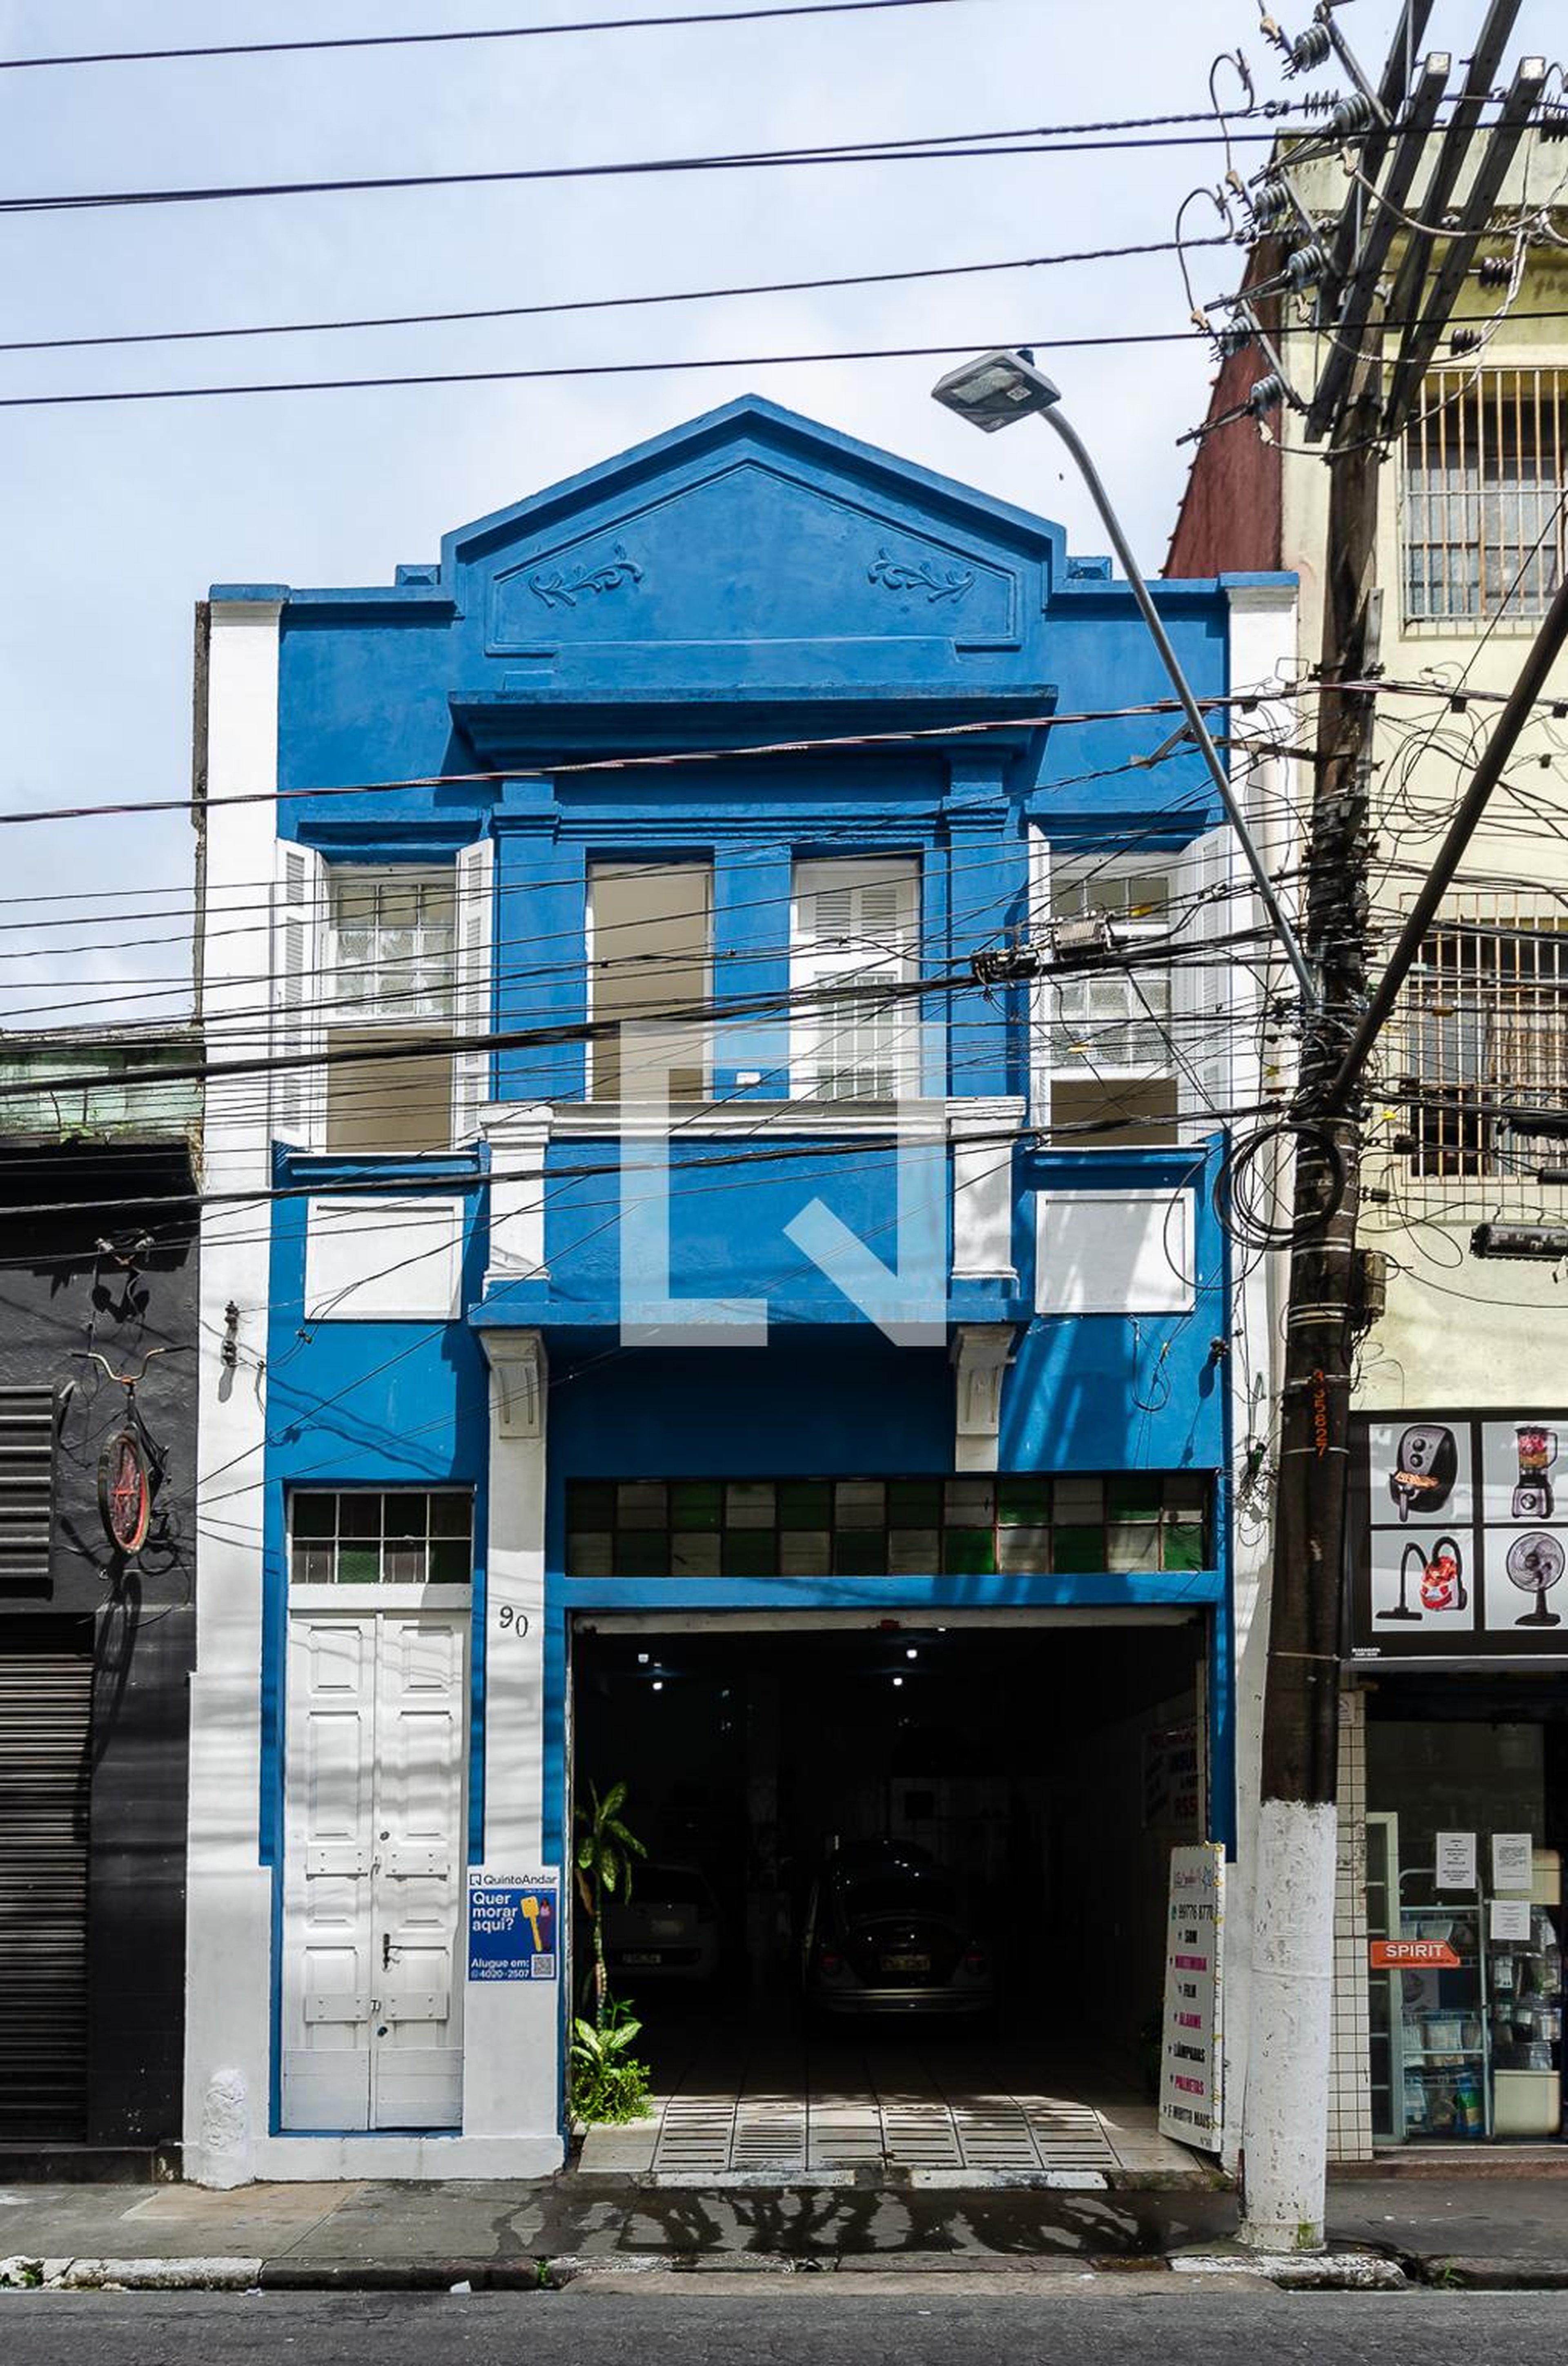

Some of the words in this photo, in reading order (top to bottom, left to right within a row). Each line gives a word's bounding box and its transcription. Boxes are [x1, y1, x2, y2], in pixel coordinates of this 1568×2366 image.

[500, 1605, 528, 1637] 90
[483, 1874, 557, 1885] QuintoAndar
[472, 1891, 511, 1905] Quer
[472, 1907, 518, 1918] morar
[472, 1919, 514, 1933] aqui?
[1385, 1944, 1445, 1957] SPIRIT
[471, 1958, 508, 1970] Alugue
